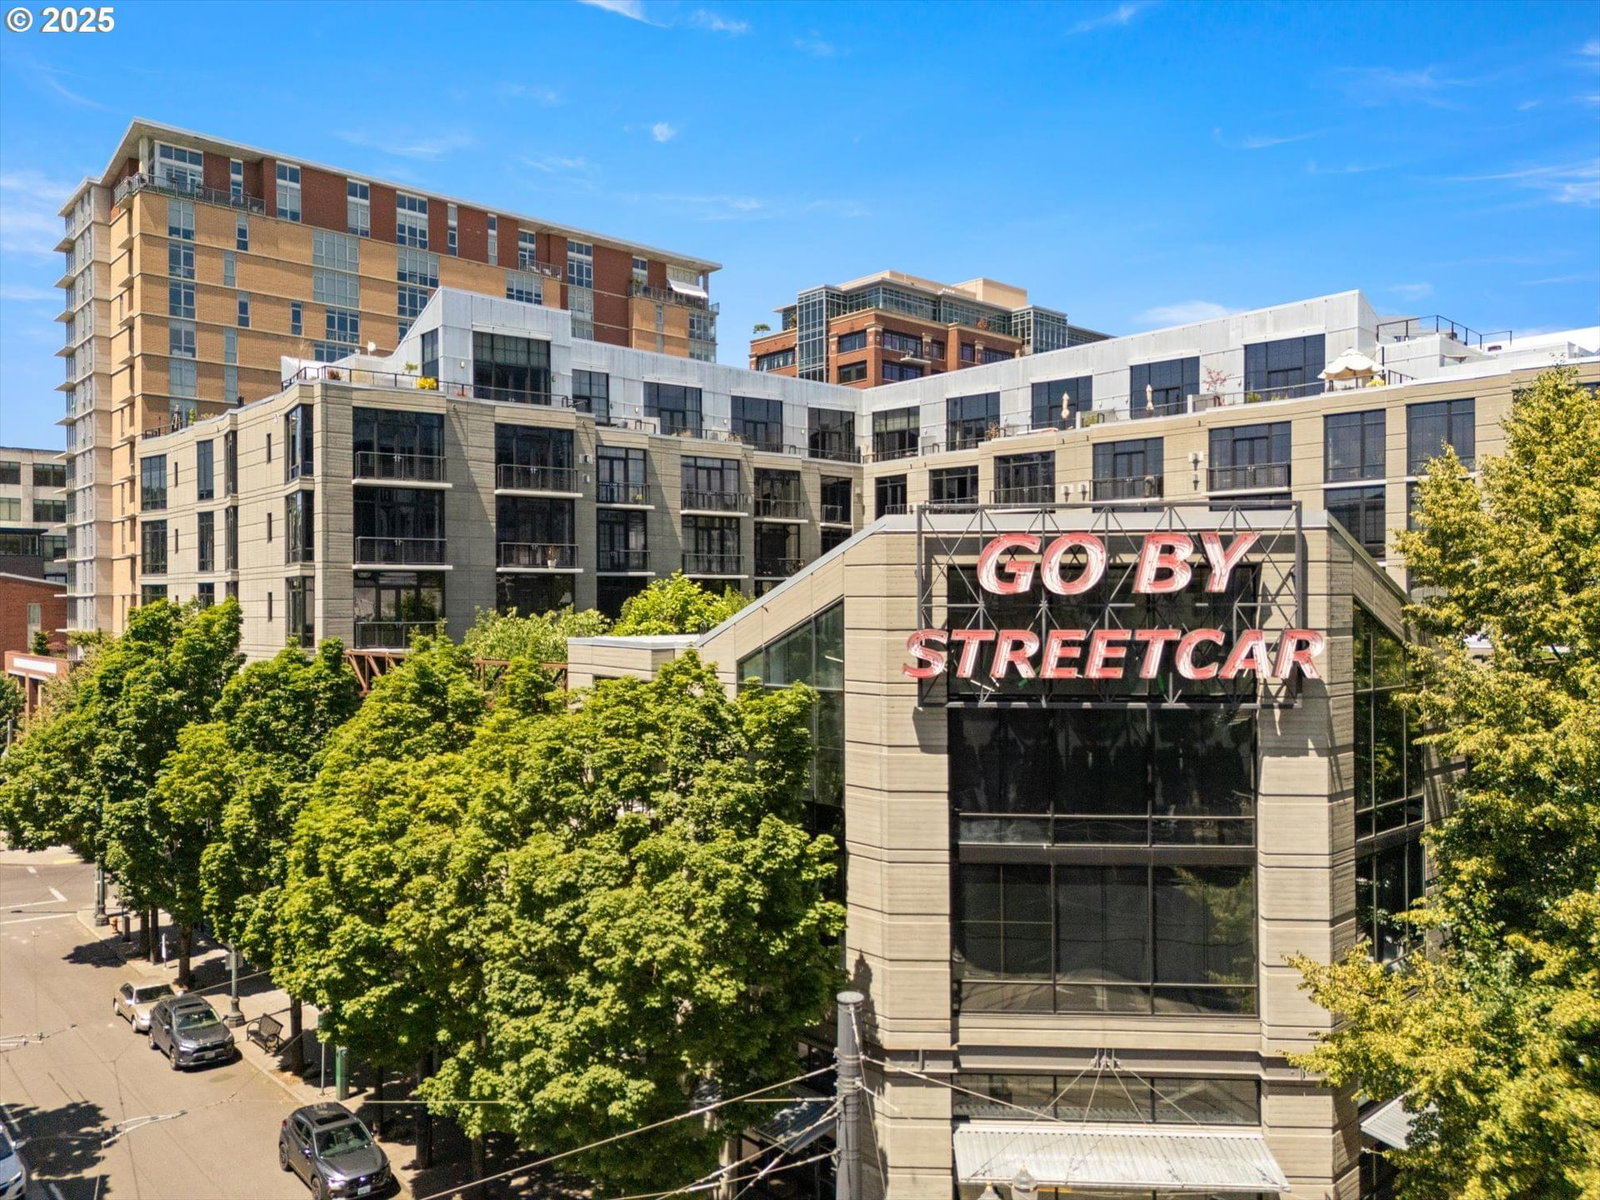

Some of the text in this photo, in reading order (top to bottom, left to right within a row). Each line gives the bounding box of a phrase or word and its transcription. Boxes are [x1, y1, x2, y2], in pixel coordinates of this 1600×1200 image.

[976, 532, 1261, 595] GO BY
[902, 628, 1325, 680] STREETCAR
